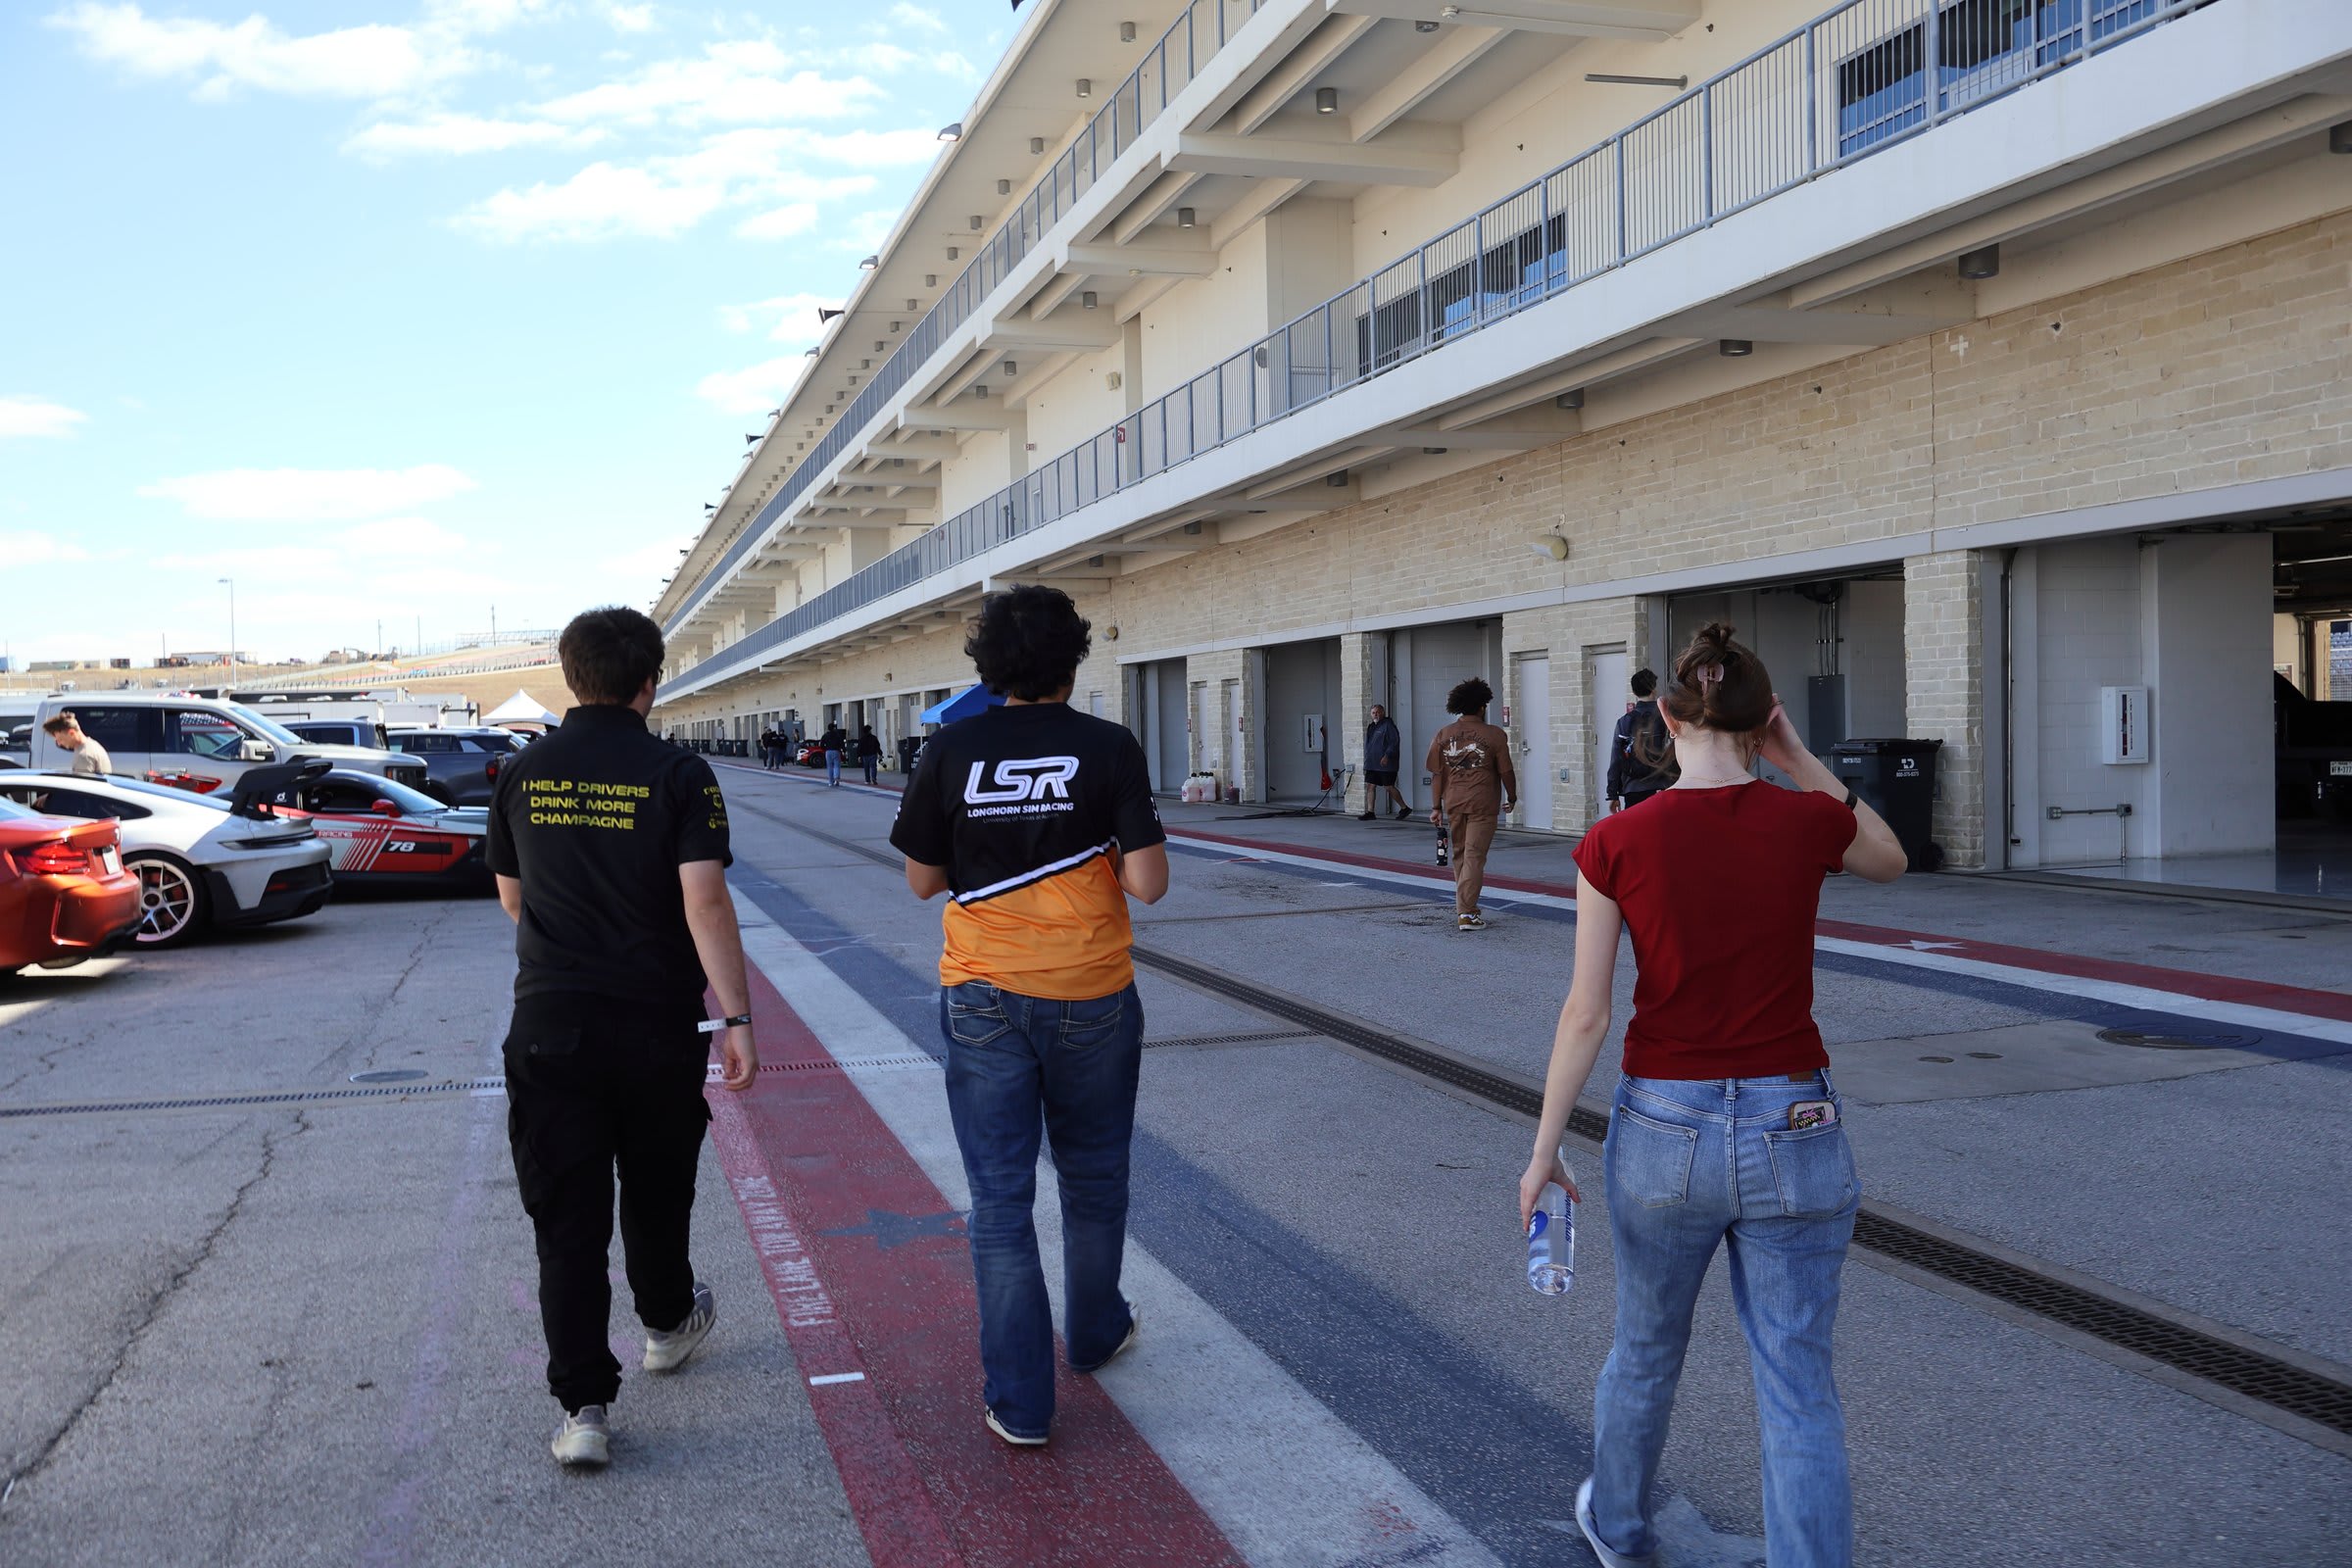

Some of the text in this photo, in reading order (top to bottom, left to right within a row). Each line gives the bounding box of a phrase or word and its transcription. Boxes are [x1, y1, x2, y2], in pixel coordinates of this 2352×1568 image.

[963, 756, 1080, 805] LSR
[522, 780, 651, 799] I HELP DRIVERS
[530, 796, 636, 813] DRINK MORE
[967, 802, 1074, 818] LONGHORN SIM RACING
[530, 812, 635, 830] CHAMPAGNE
[388, 841, 416, 853] 78
